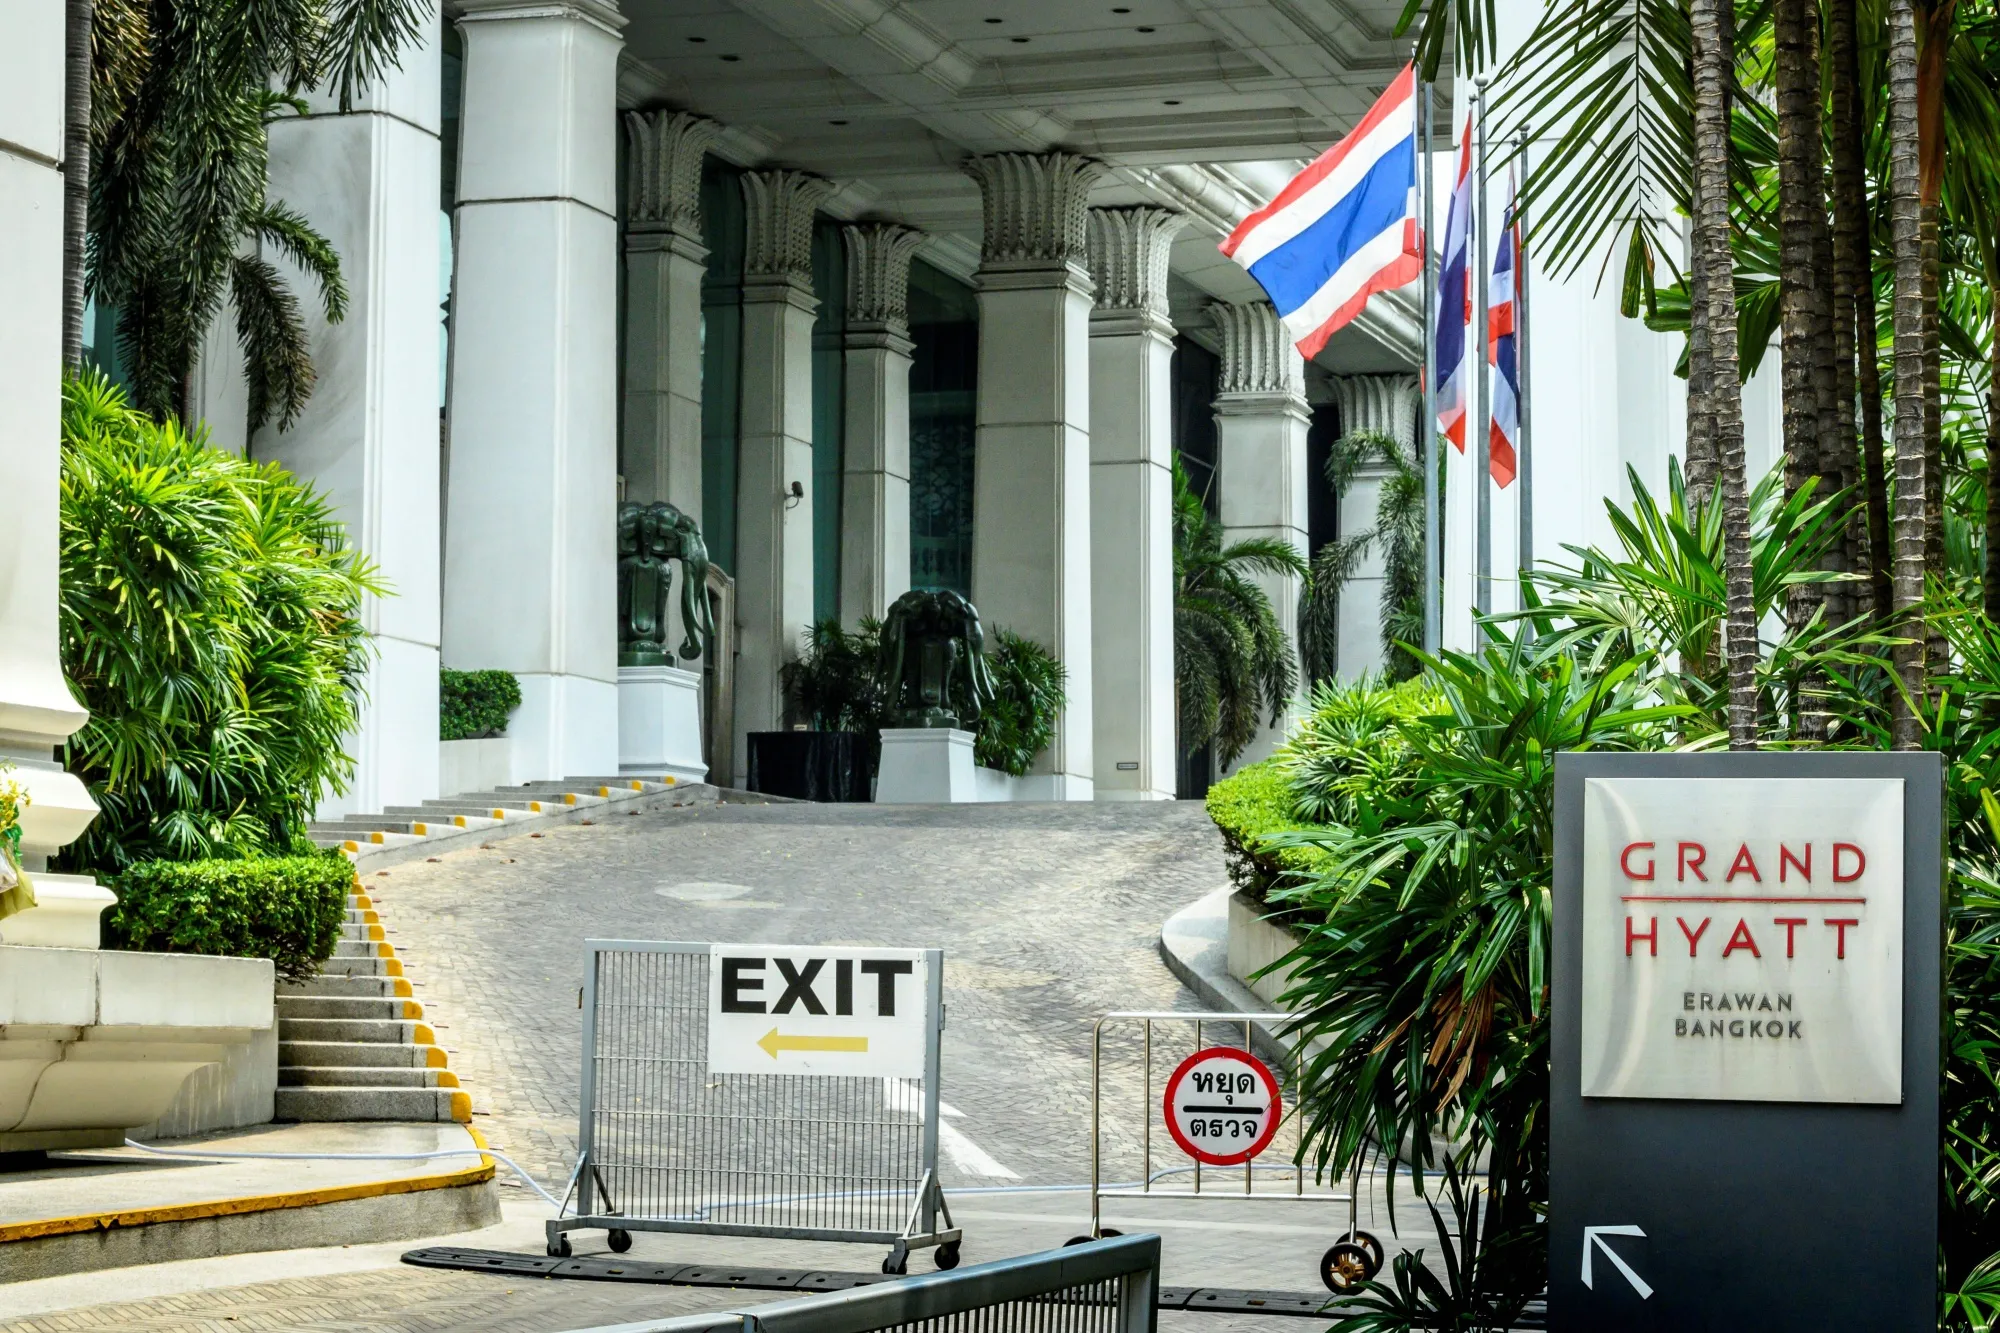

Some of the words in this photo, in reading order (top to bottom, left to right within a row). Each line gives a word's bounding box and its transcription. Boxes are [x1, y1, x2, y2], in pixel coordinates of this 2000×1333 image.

[1620, 841, 1867, 883] GRAND
[1625, 916, 1860, 960] HYATT
[721, 957, 913, 1017] EXIT
[1683, 992, 1792, 1012] ERAWAN
[1675, 1018, 1802, 1039] BANGKOK
[1191, 1072, 1255, 1105] หยุด
[1190, 1119, 1258, 1138] ตรวจ
